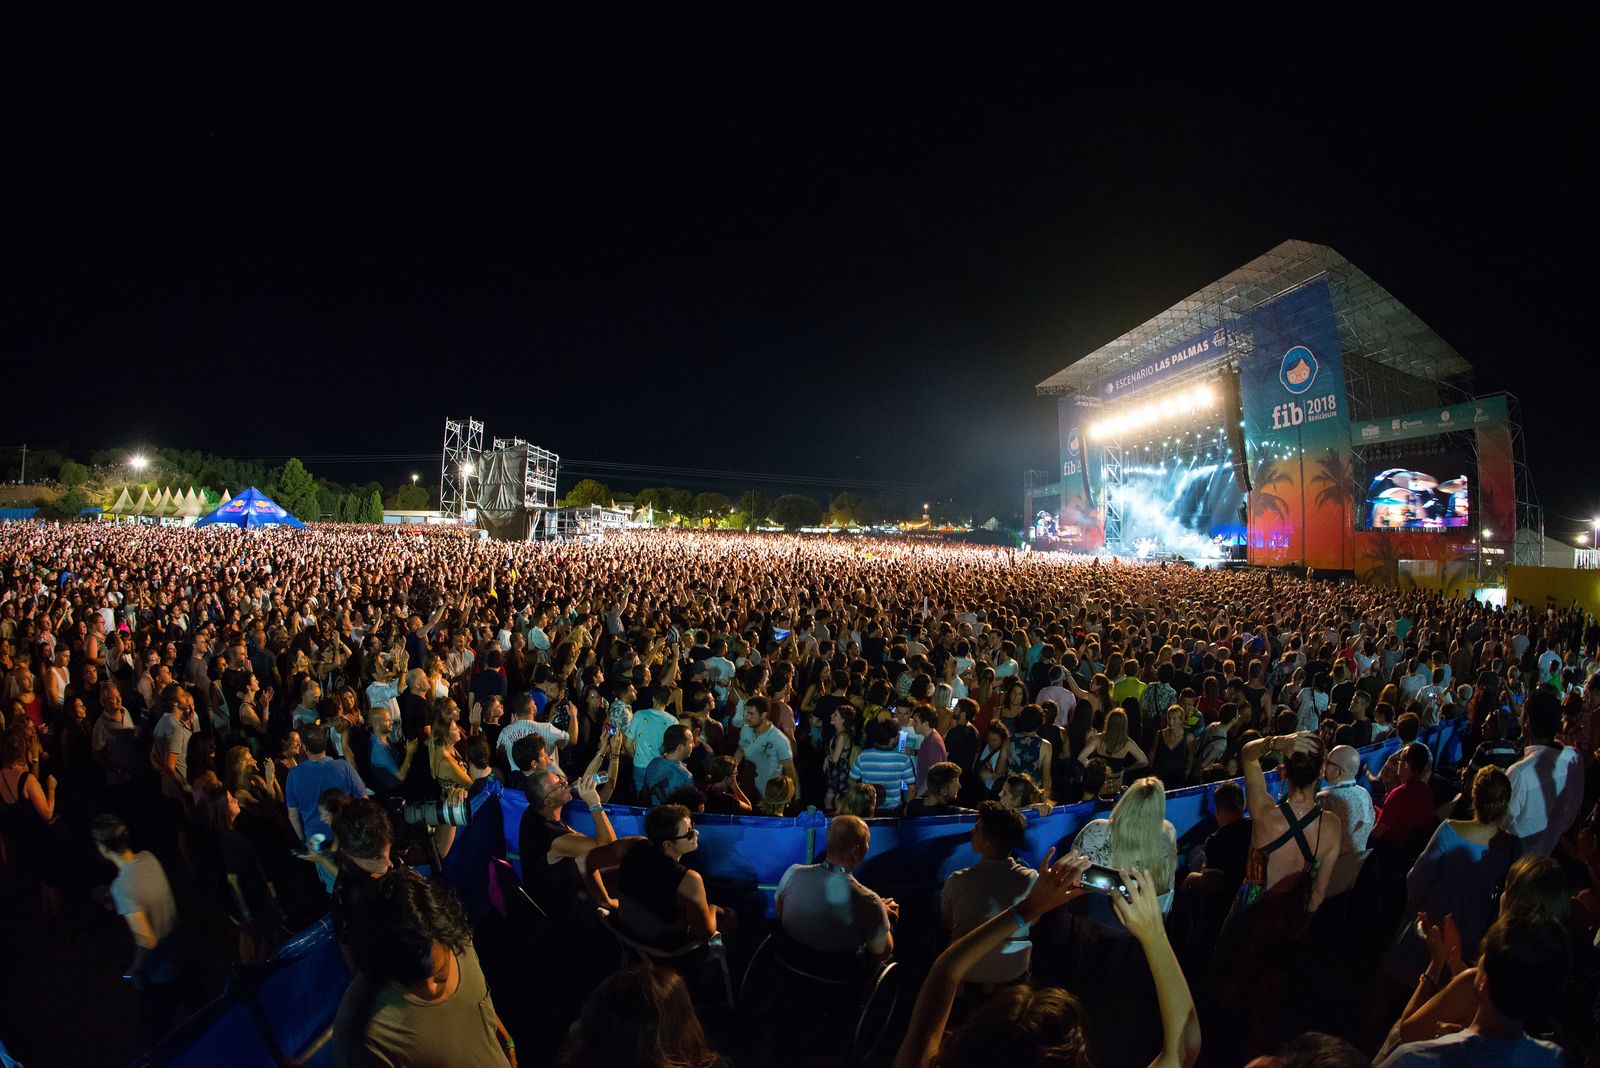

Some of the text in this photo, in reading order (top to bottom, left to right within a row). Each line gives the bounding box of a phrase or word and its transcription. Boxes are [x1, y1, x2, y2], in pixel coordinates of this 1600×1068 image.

[1115, 340, 1209, 389] ESCENARIO LAS PALMAS
[1272, 394, 1336, 430] fib 2018
